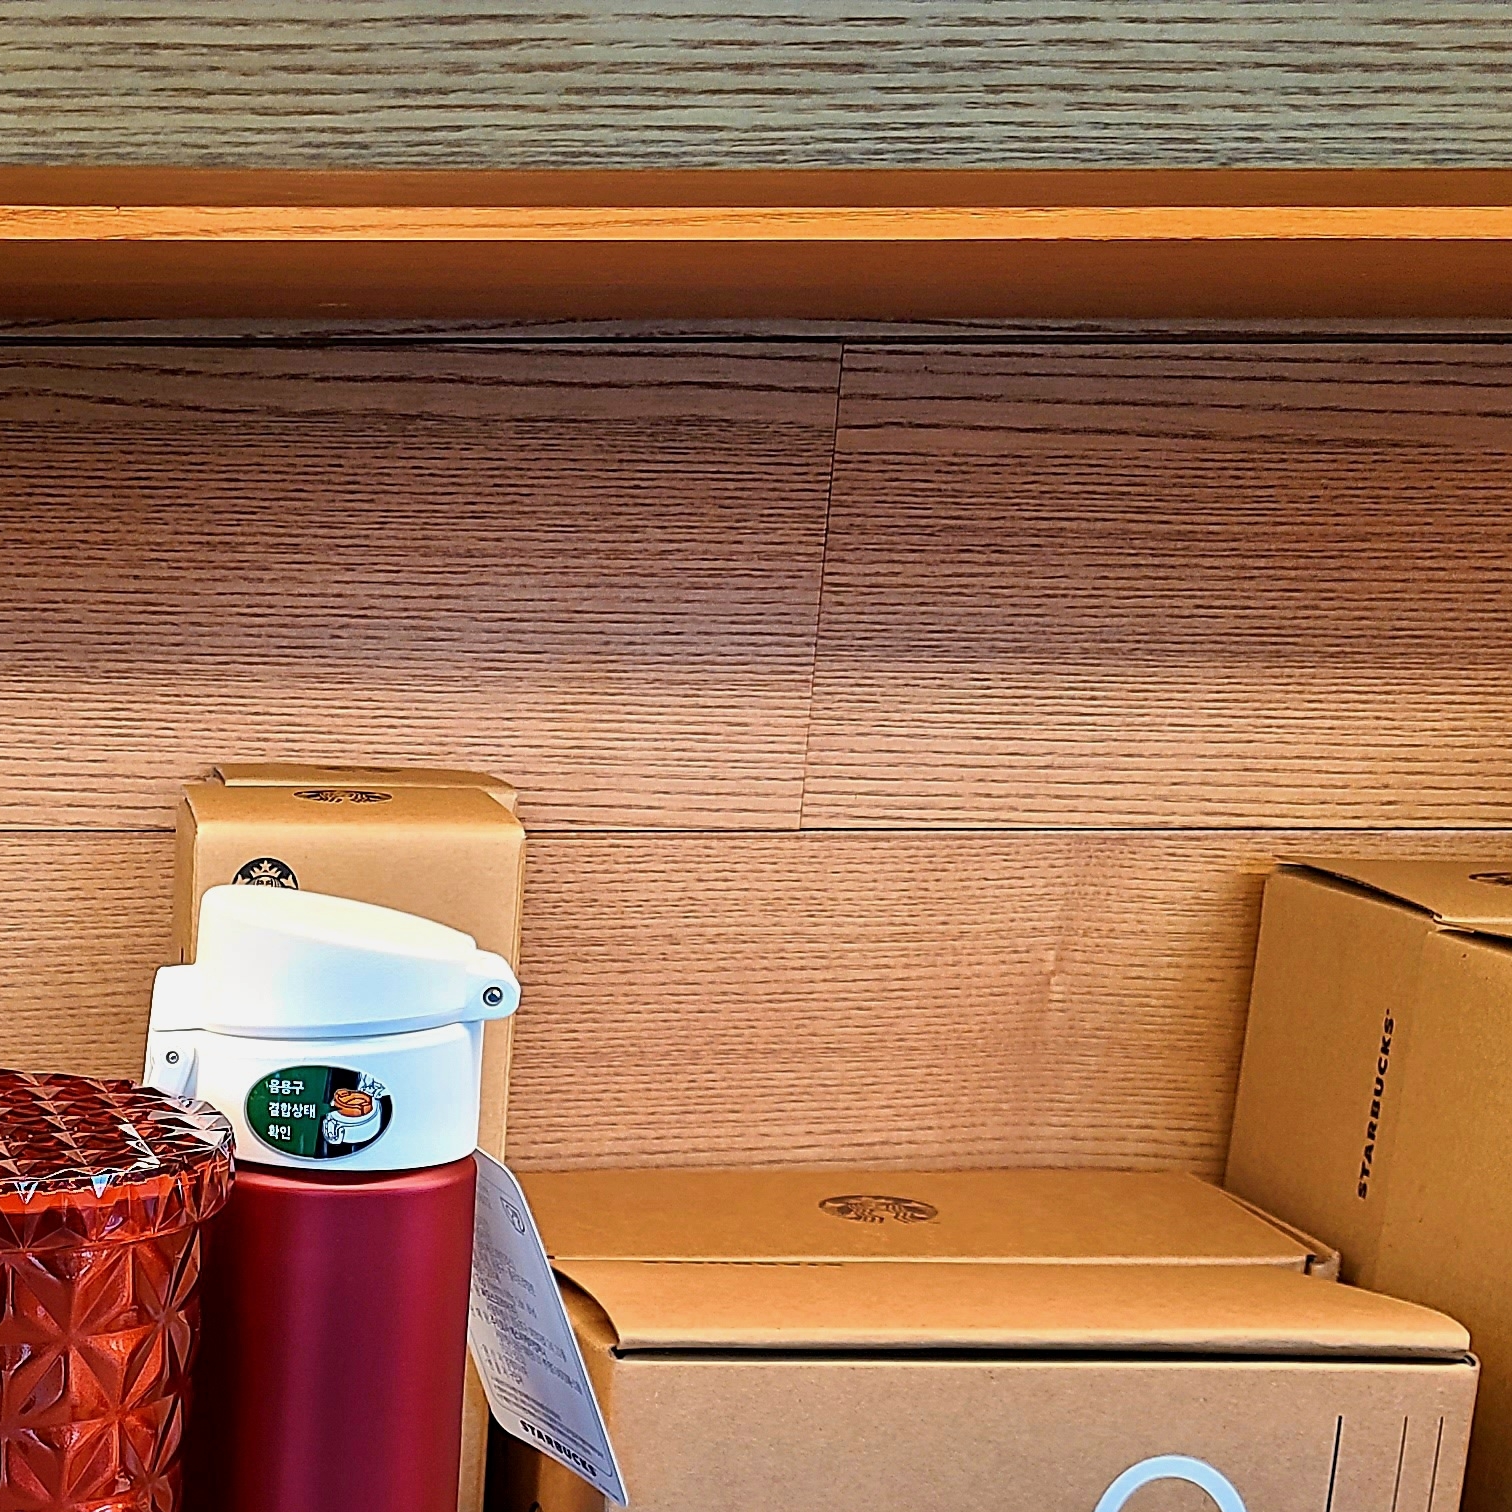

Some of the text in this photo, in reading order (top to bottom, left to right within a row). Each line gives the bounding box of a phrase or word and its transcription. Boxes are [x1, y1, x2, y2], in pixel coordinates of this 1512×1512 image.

[268, 1079, 305, 1095] 음용구
[268, 1102, 316, 1118] 결합상태
[1357, 1015, 1395, 1199] STARBUCKS
[267, 1124, 291, 1140] 확인
[519, 1420, 597, 1478] STARBUCKS
